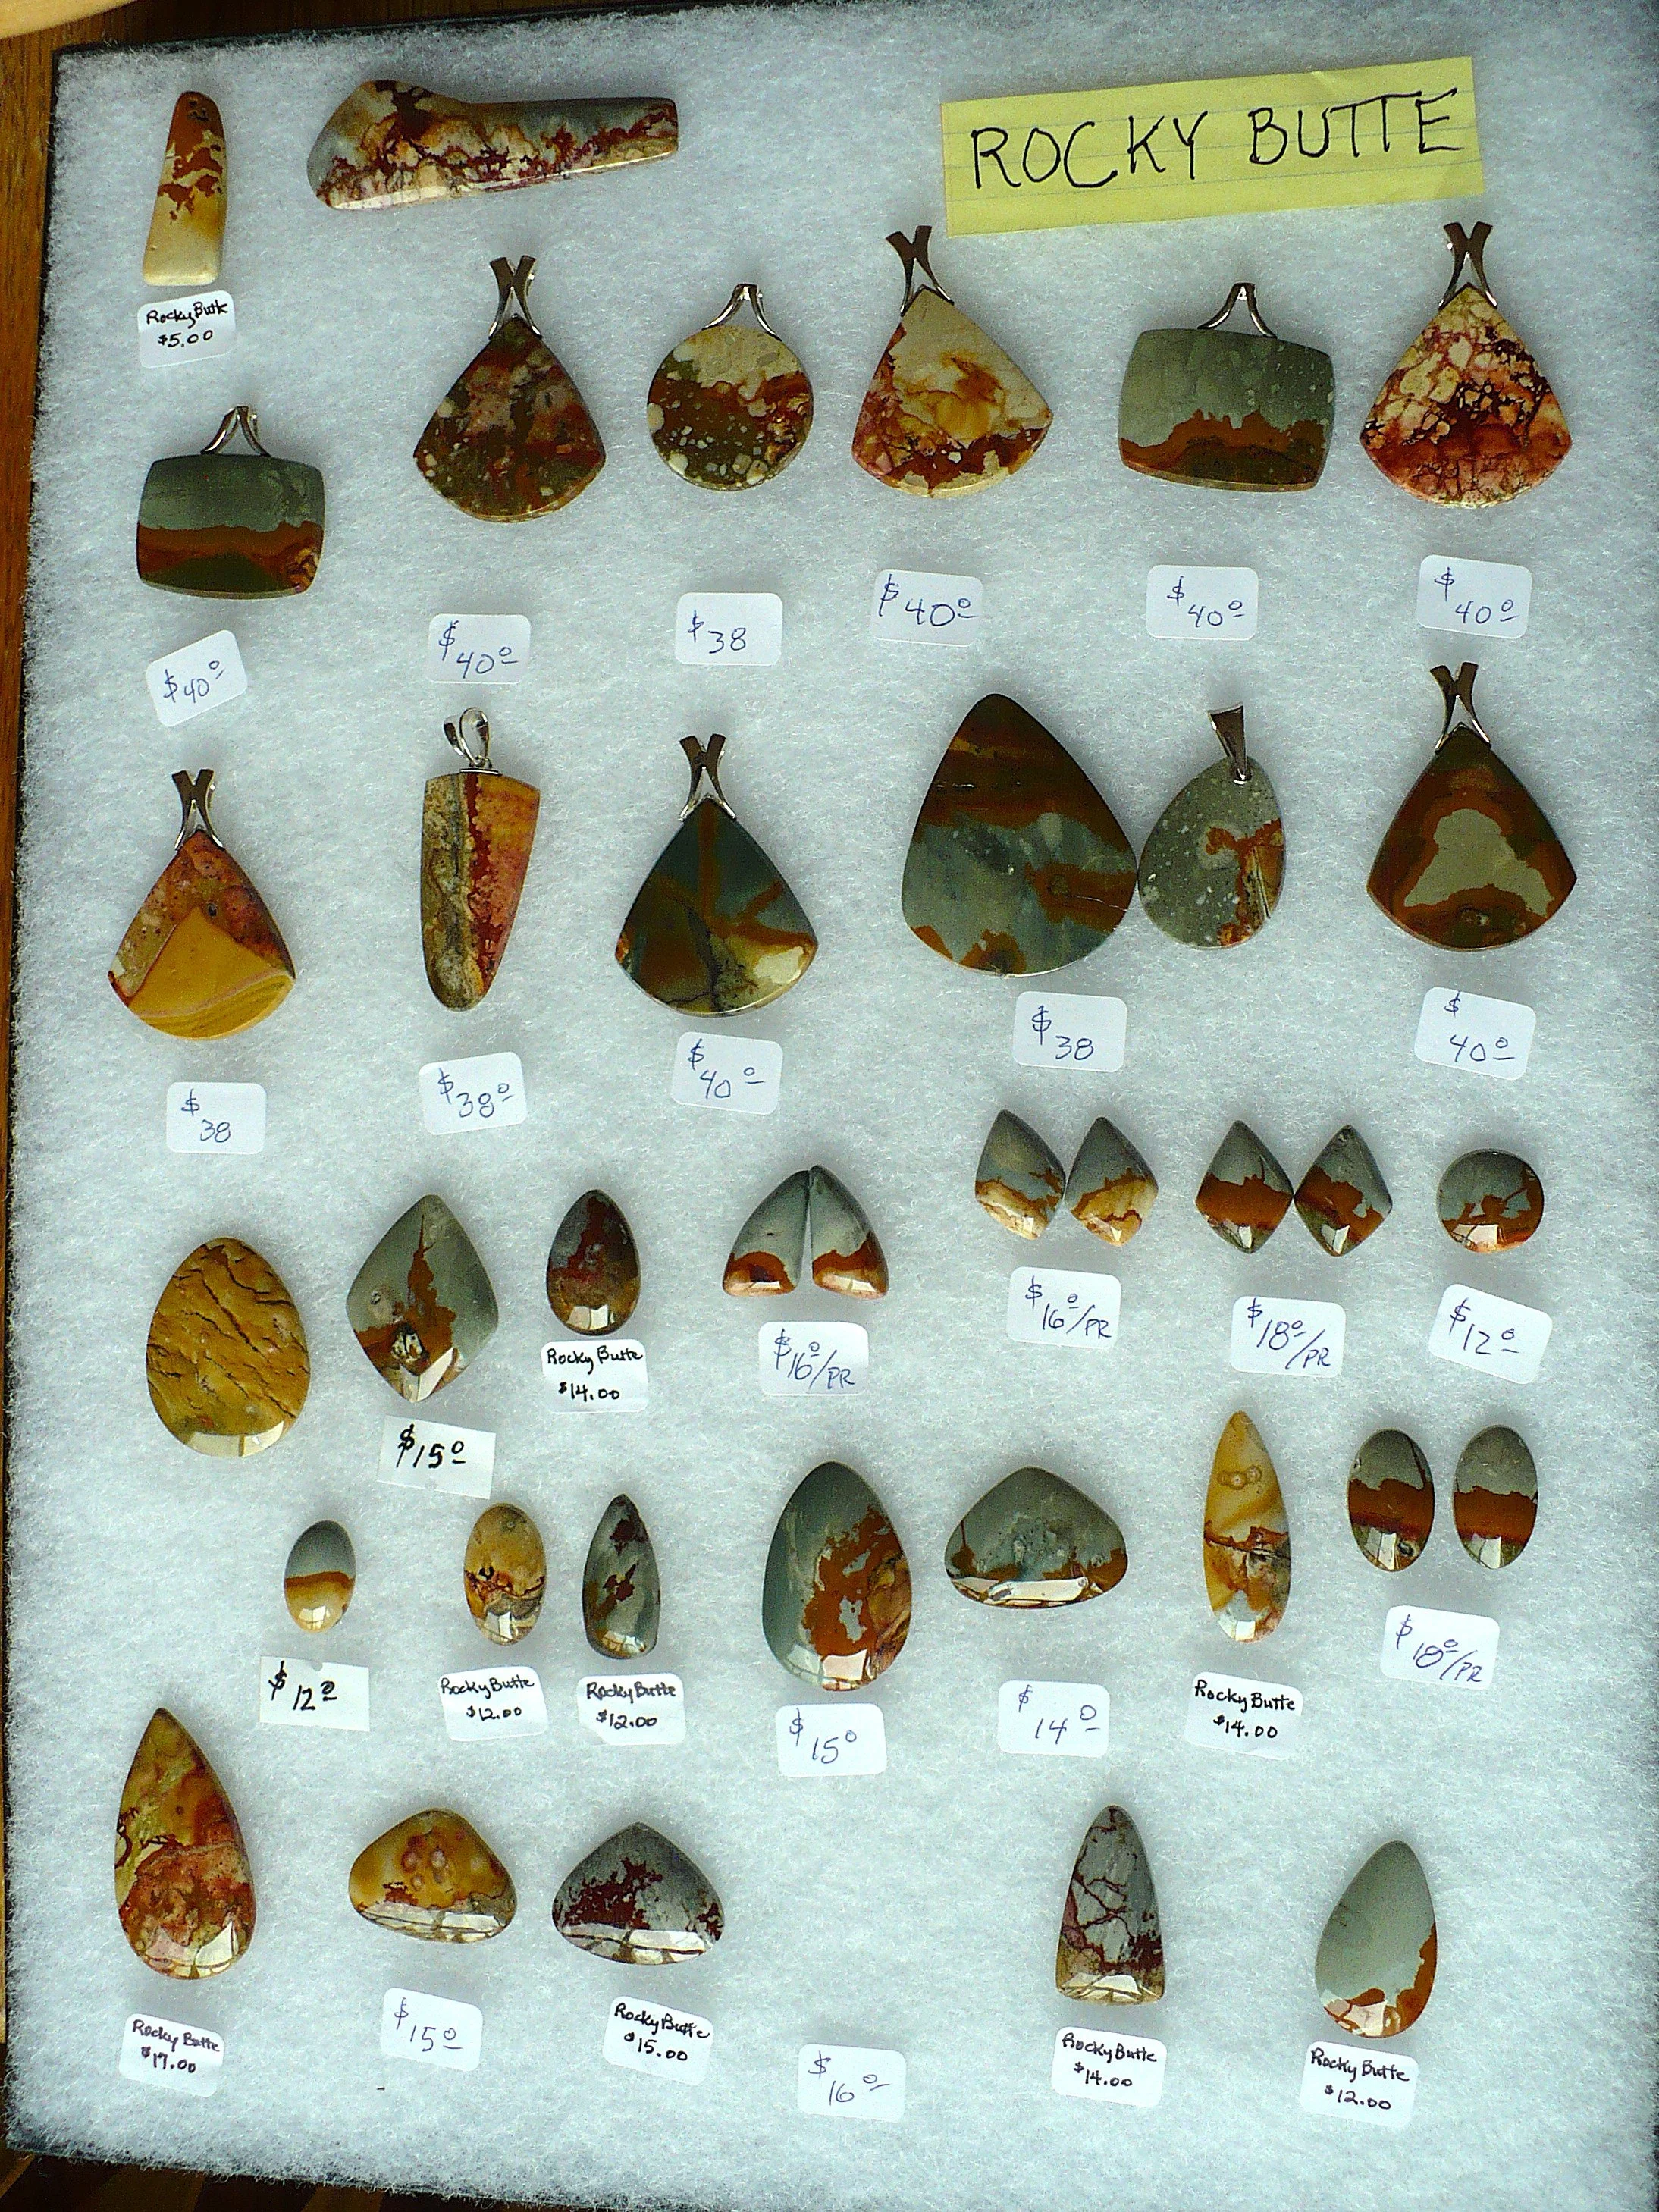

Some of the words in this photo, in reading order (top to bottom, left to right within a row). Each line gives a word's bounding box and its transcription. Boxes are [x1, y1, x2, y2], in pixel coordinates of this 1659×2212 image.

[971, 111, 1208, 188] ROCKY
[1247, 88, 1463, 165] BUTTE
[146, 309, 196, 330] Rocky
[157, 329, 214, 348] $5.00
[687, 610, 747, 654] $38
[1030, 1005, 1094, 1061] $38
[180, 1087, 231, 1143] $38
[546, 1348, 595, 1375] Rocky
[558, 1380, 621, 1402] $14.00
[440, 1677, 491, 1700] Rocky
[585, 1682, 636, 1705] Rocky
[1194, 1678, 1250, 1714] Rocky
[1250, 1693, 1297, 1712] Butte
[465, 1705, 522, 1722] $12.00
[595, 1708, 658, 1730] $12.00
[1212, 1714, 1278, 1740] $14.00
[613, 2001, 660, 2035] Rocky
[132, 2019, 179, 2052] Rocky
[1062, 2032, 1115, 2063] Rocky
[1073, 2061, 1134, 2088] $14.00
[1310, 2047, 1358, 2083] Rocky
[1324, 2085, 1392, 2110] $12.00
